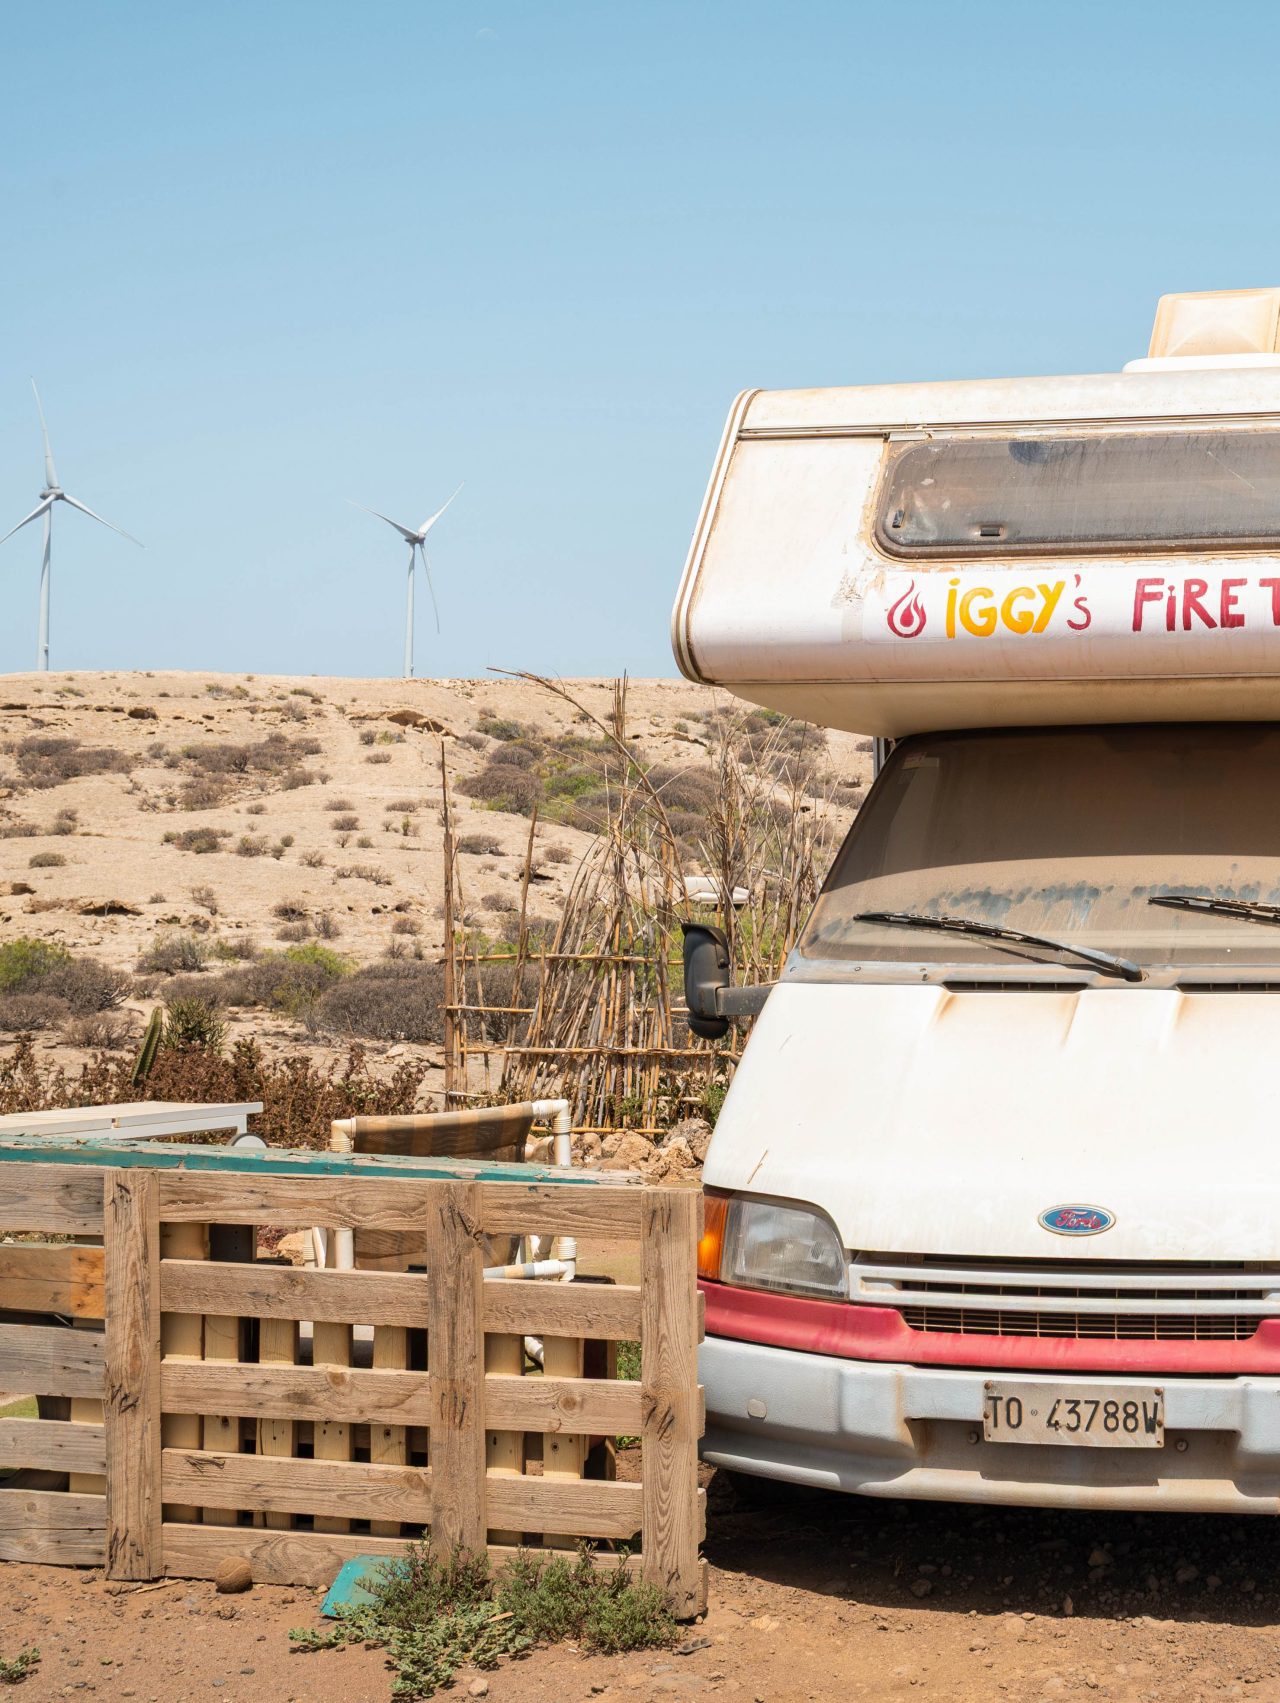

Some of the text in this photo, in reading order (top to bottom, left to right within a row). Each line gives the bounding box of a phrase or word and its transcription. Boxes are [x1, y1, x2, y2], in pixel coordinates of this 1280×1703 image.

[1055, 1209, 1101, 1229] Ford
[987, 1395, 1159, 1434] TO 43788W
